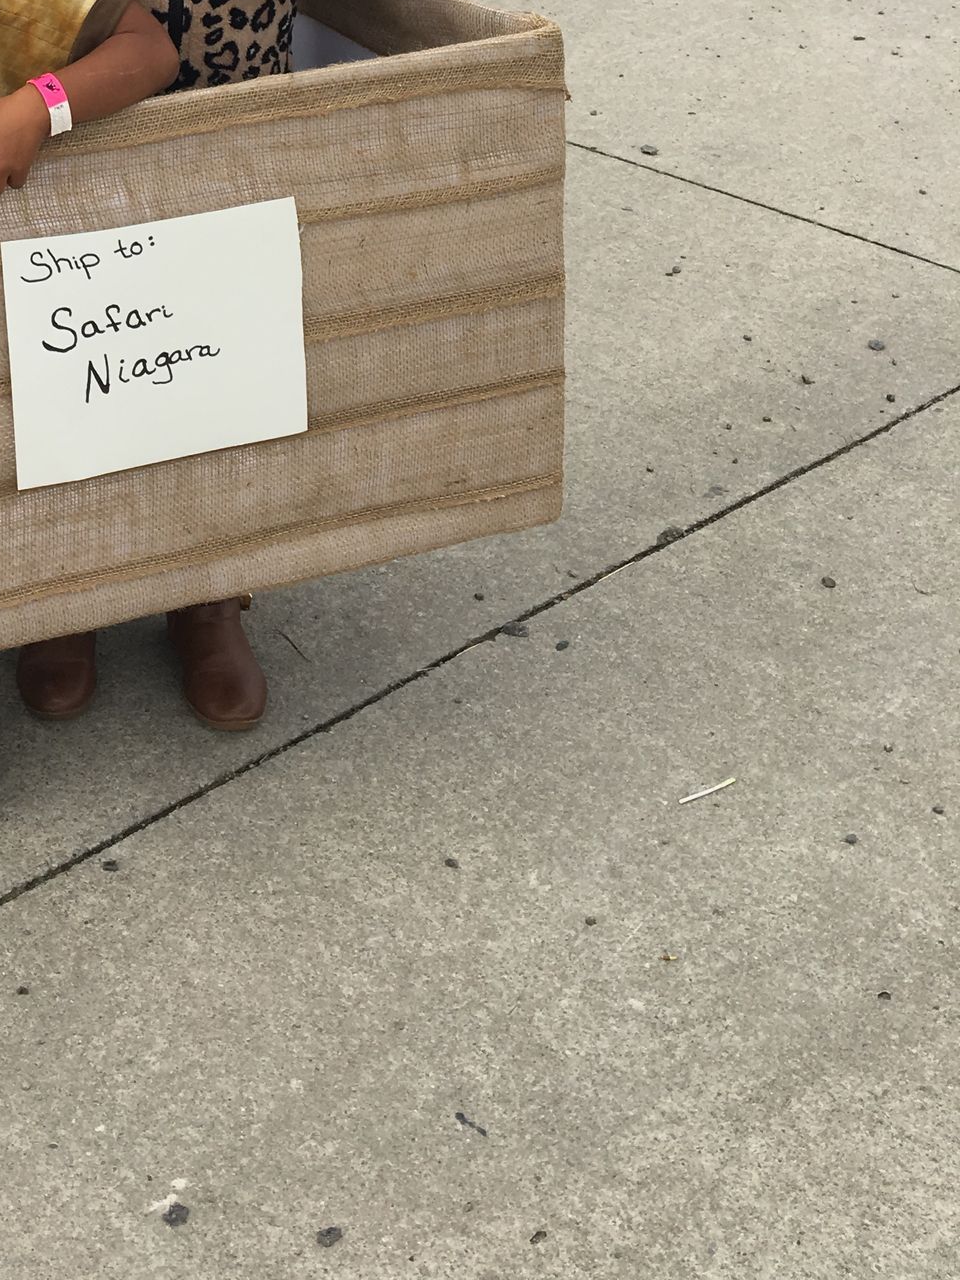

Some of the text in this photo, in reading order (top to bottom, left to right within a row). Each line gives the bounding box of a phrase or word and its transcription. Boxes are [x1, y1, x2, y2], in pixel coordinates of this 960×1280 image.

[20, 235, 156, 283] Ship to:
[41, 303, 174, 354] Safari
[85, 343, 221, 404] Niagara
